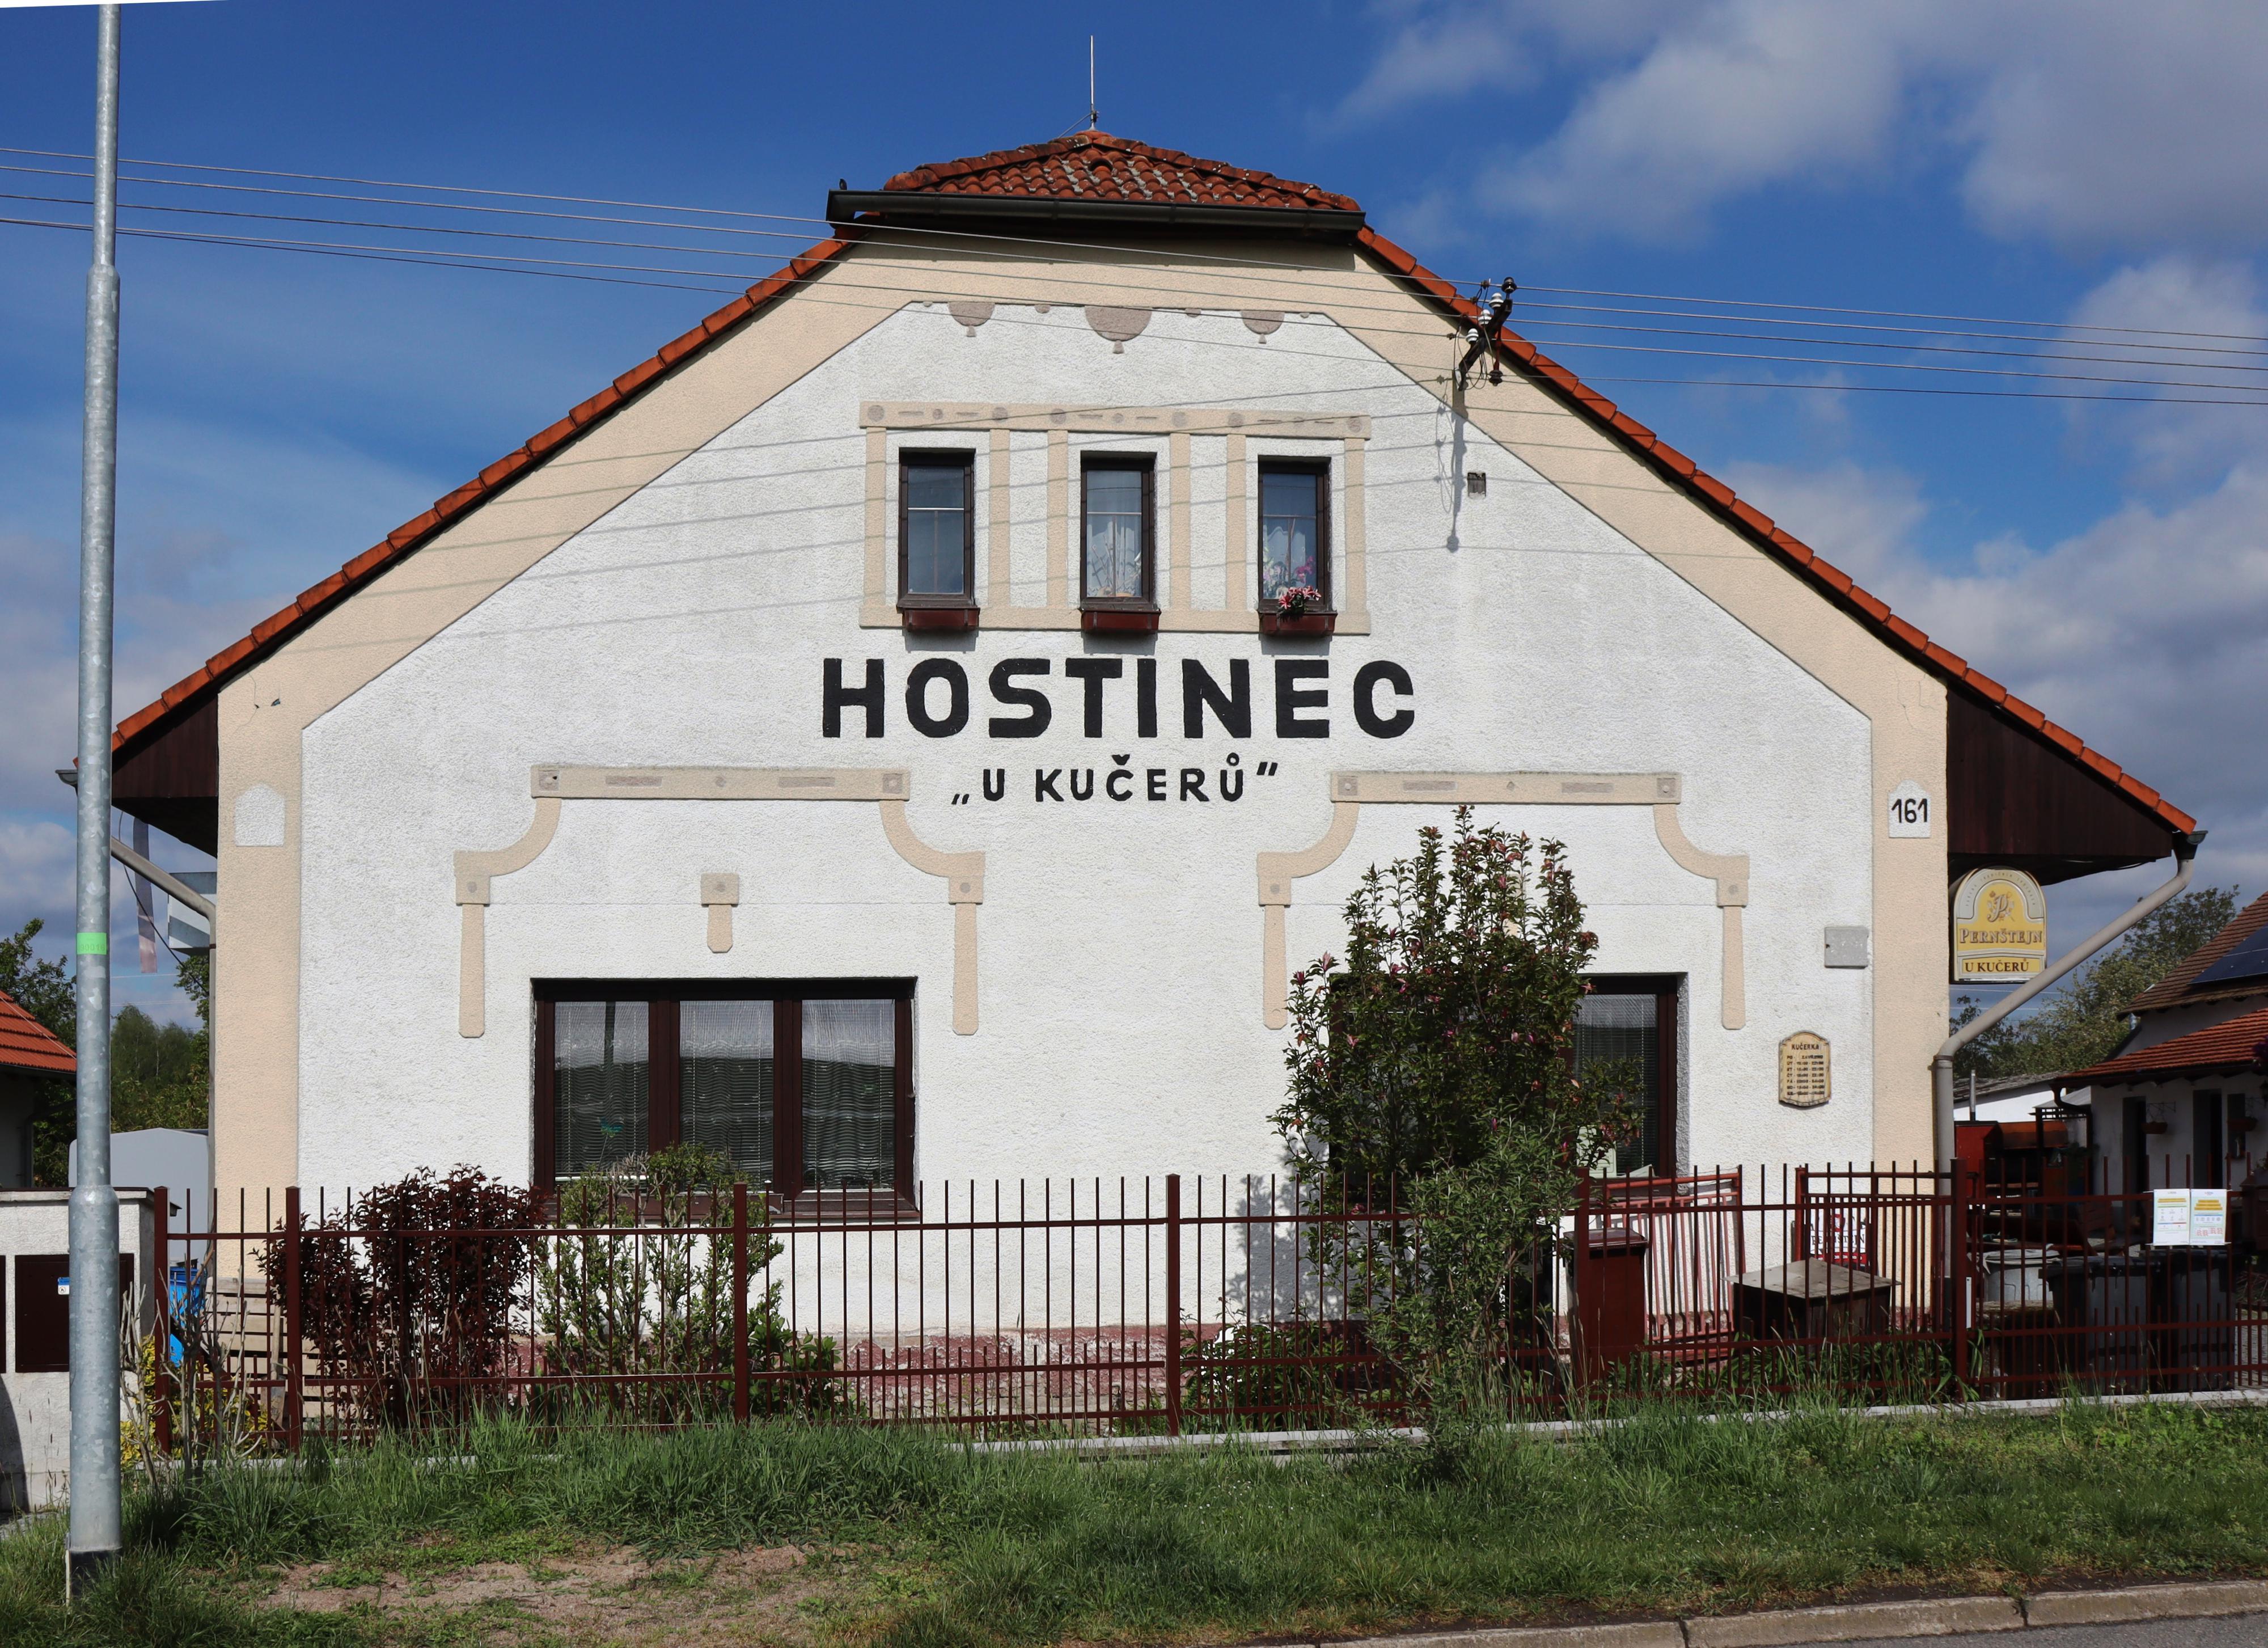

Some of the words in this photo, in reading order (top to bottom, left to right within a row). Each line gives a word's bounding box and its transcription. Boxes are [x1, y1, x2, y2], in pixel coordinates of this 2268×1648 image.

[822, 658, 1415, 739] HOSTINEC
[1892, 798, 1927, 823] 161
[1960, 928, 2042, 945] PERNŠTEJN
[1965, 962, 1974, 972] U
[1978, 958, 2029, 972] KUČERŮ
